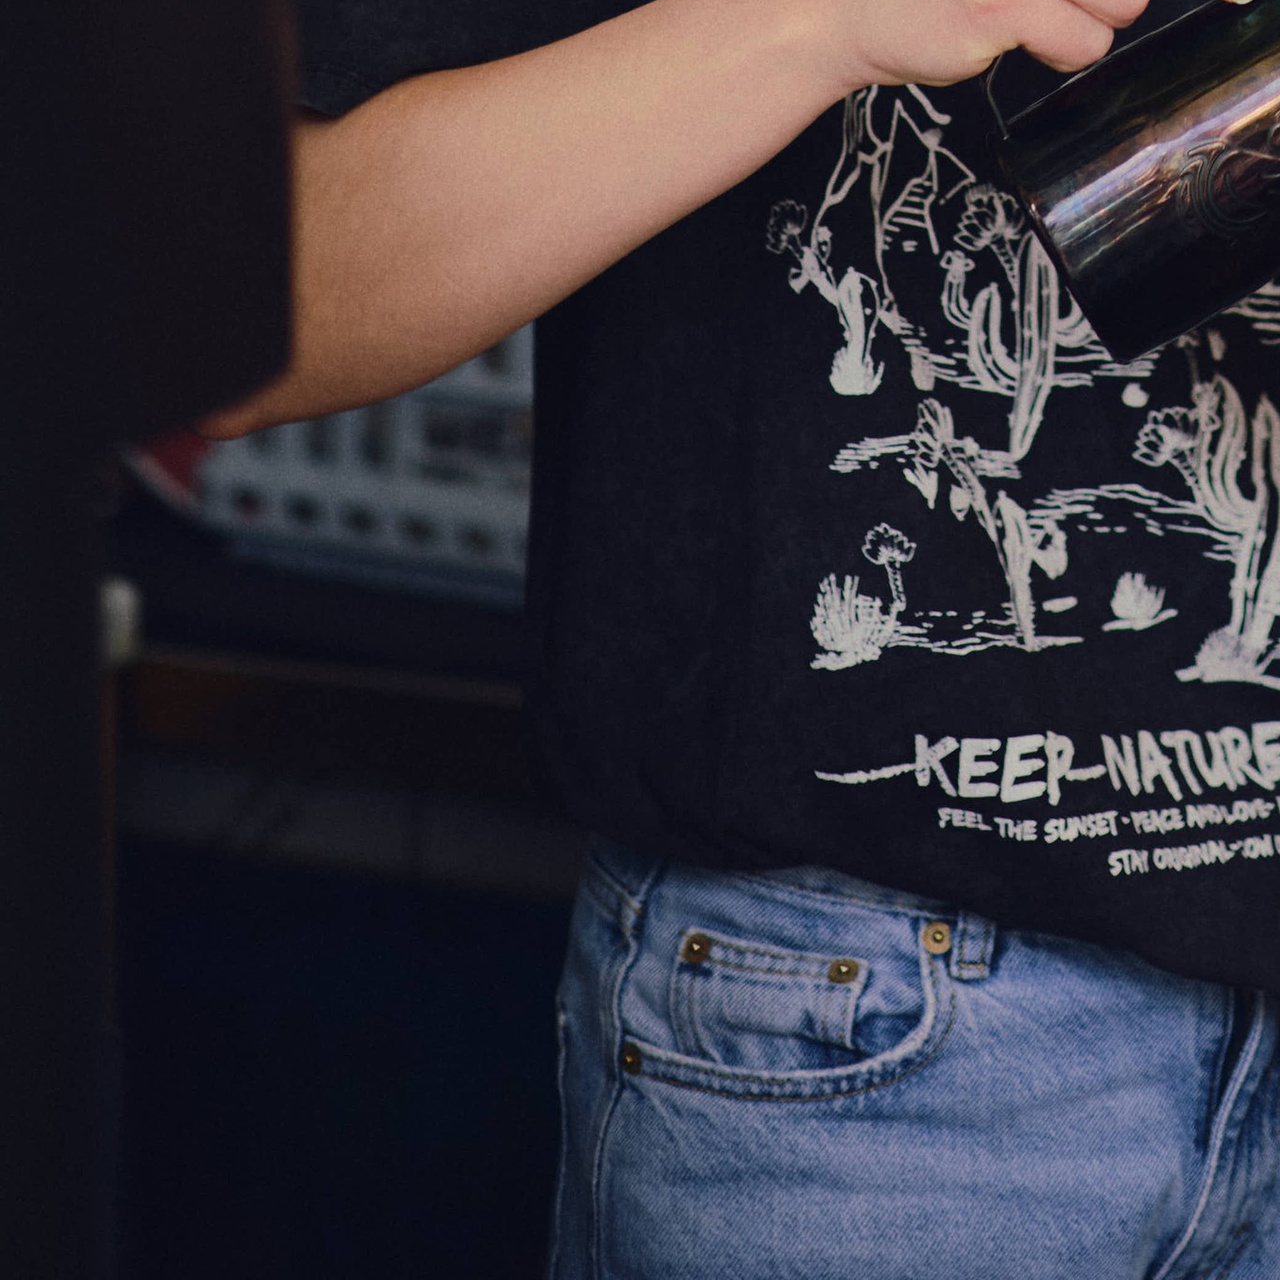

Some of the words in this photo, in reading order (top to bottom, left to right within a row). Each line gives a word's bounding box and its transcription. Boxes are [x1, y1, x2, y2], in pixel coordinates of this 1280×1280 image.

[913, 731, 1075, 806] KEEP
[937, 807, 992, 831] FEEL
[993, 816, 1039, 841] THE
[1043, 810, 1119, 844] SUNSET
[1130, 807, 1185, 835] PEACE
